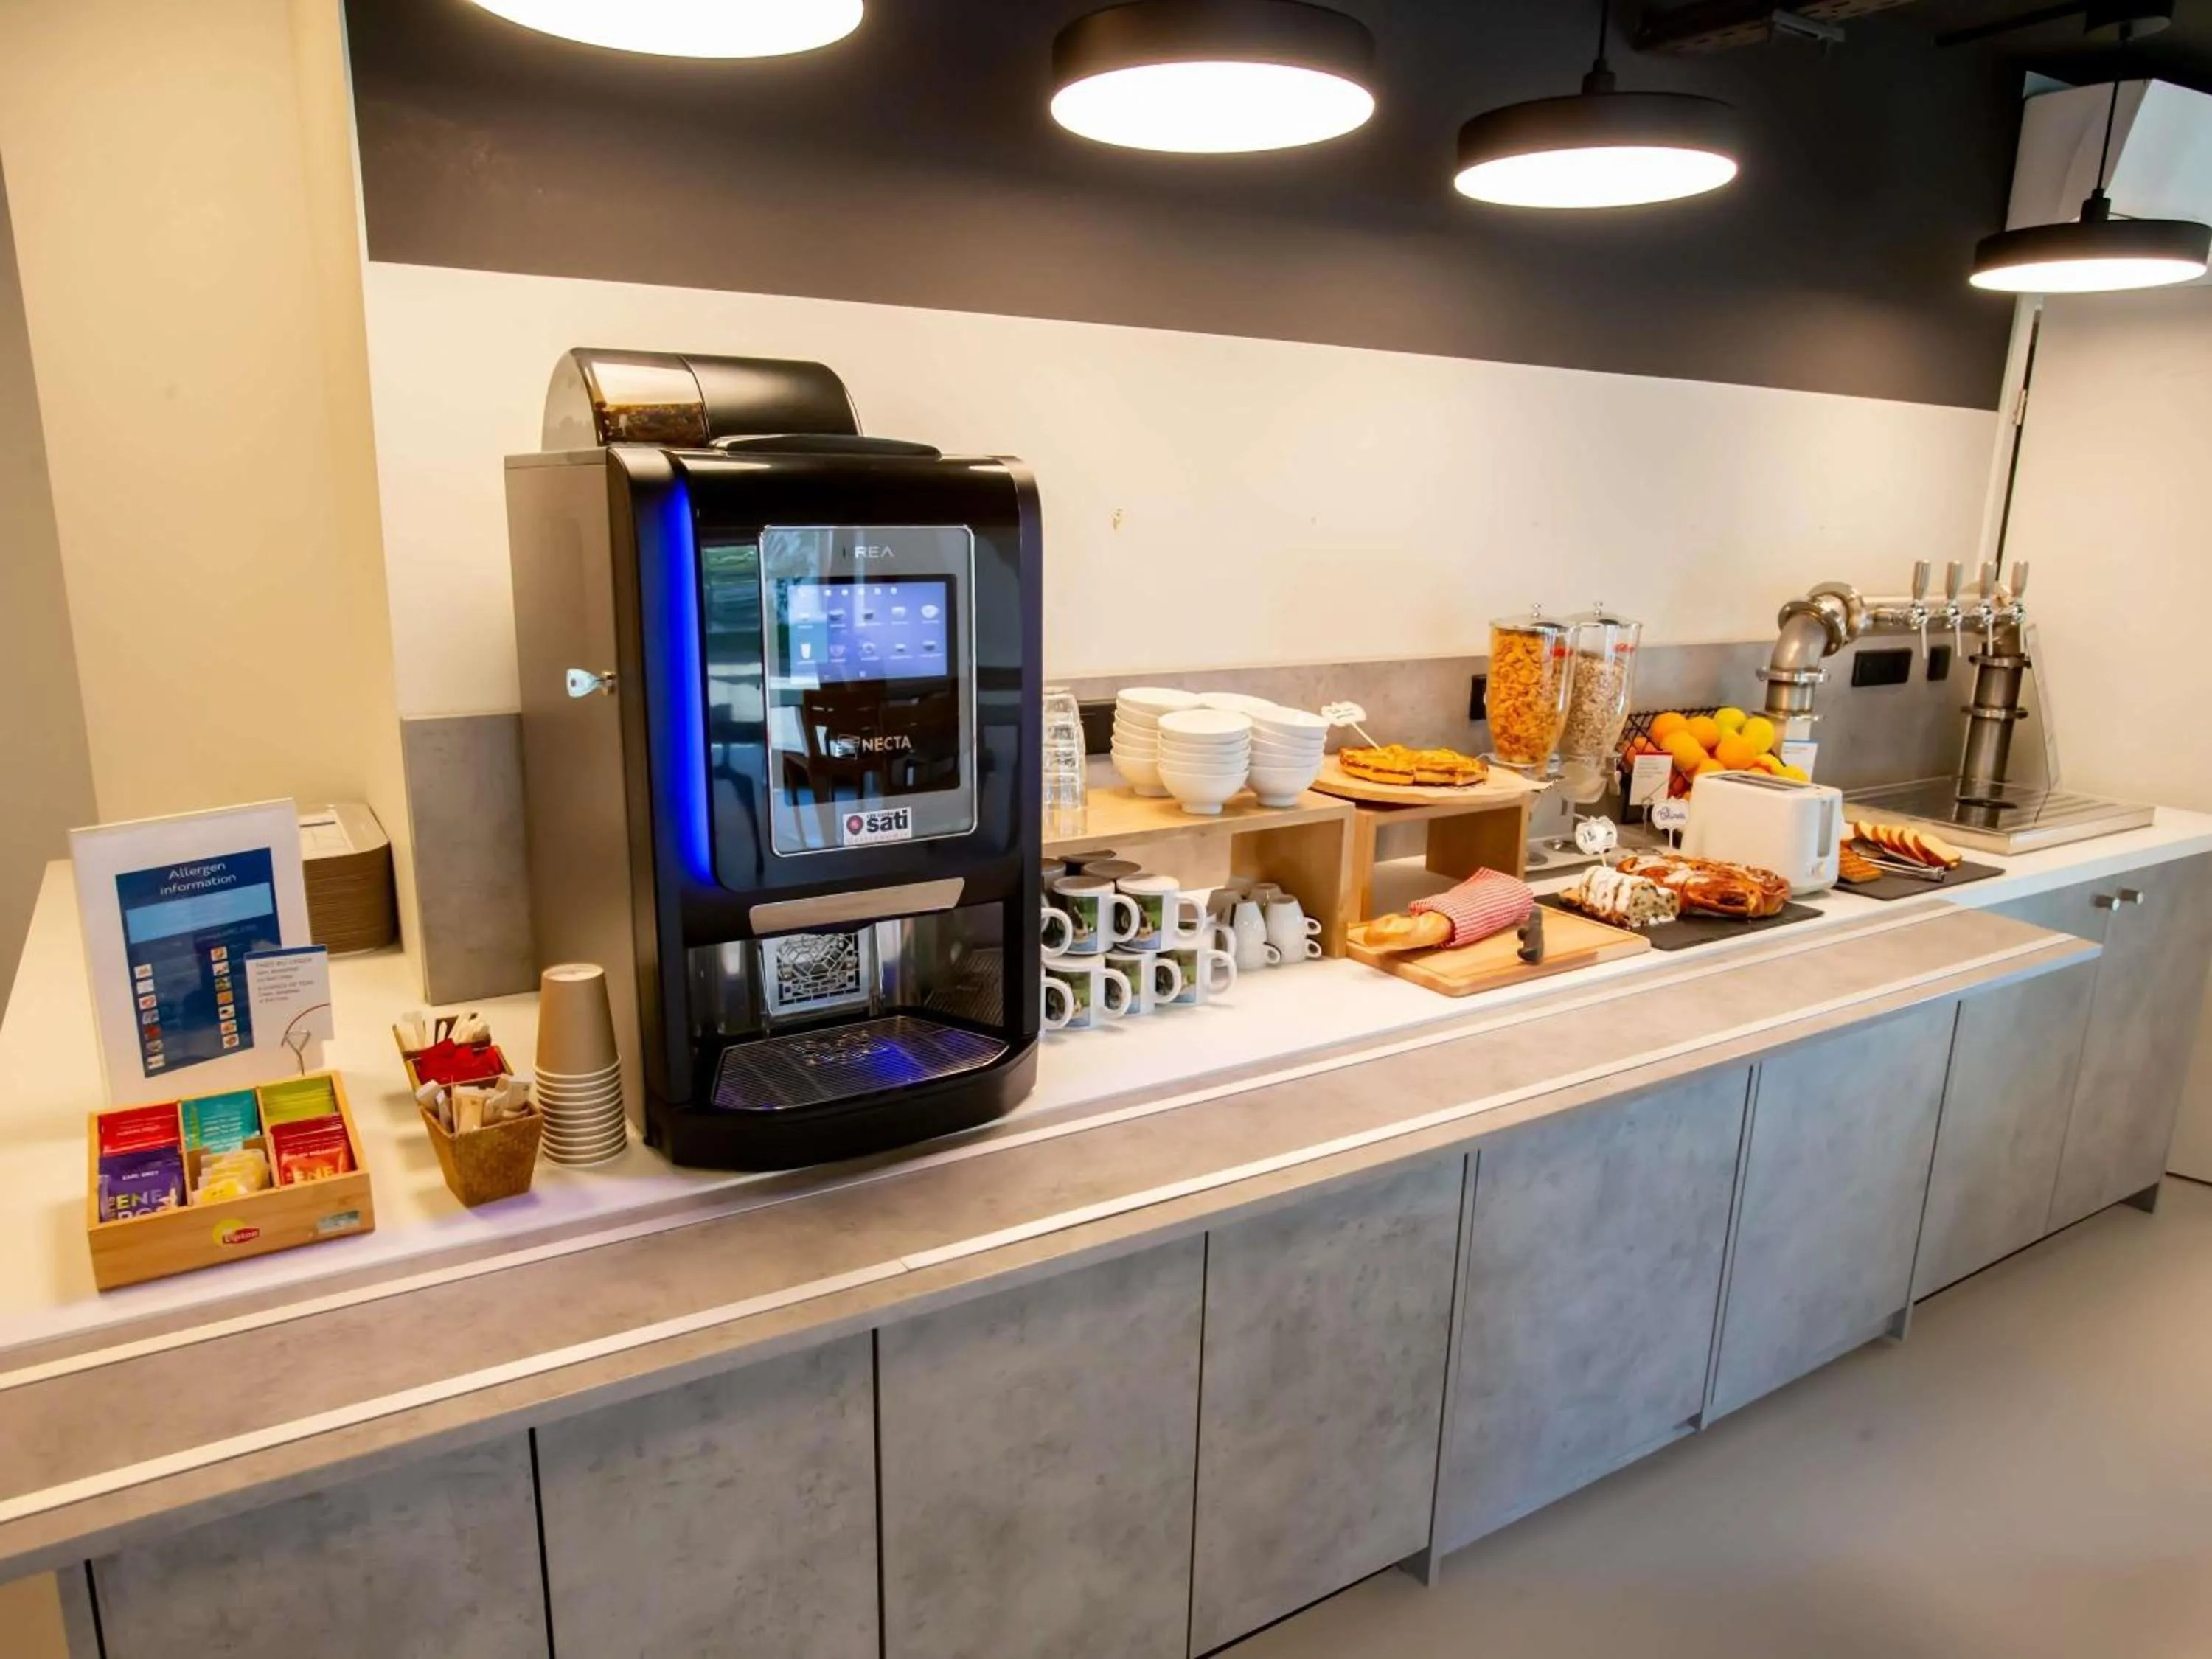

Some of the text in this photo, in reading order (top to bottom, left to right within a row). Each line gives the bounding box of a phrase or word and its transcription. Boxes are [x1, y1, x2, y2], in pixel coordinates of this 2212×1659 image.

[862, 735, 912, 752] NECTA
[866, 809, 908, 832] sati
[169, 863, 226, 880] Allergen
[160, 874, 237, 896] information
[224, 1231, 258, 1243] Lipton
